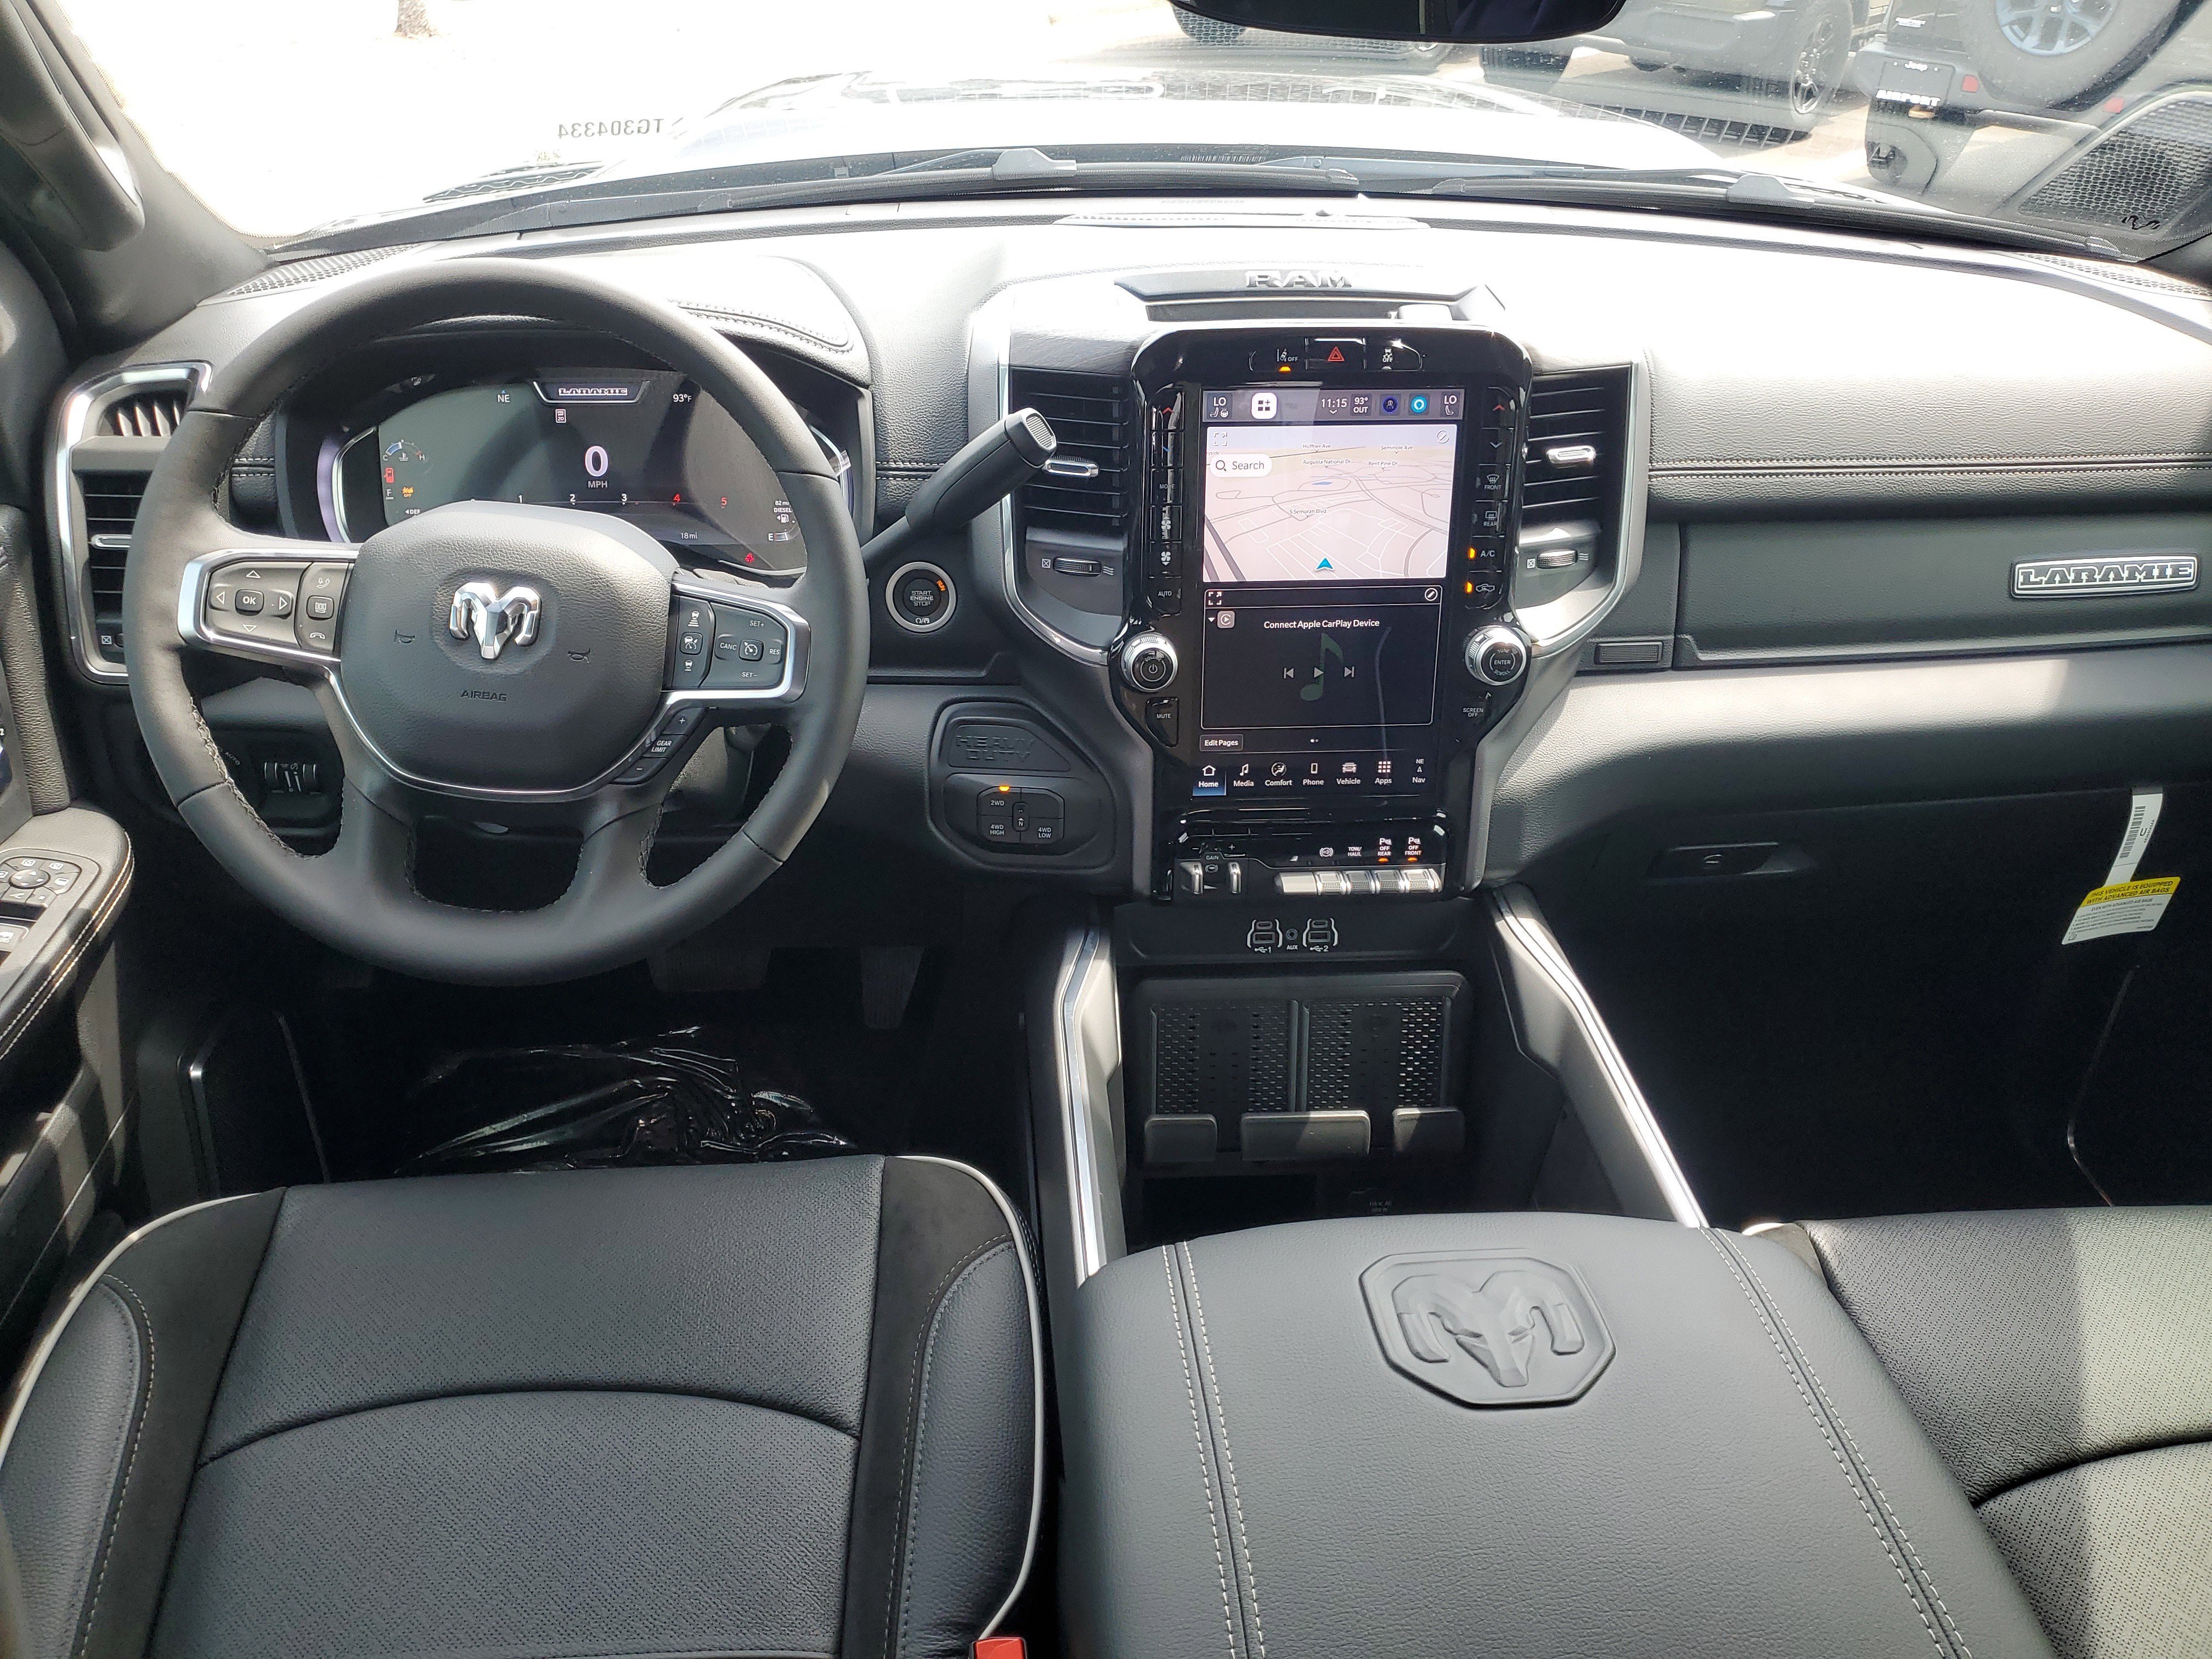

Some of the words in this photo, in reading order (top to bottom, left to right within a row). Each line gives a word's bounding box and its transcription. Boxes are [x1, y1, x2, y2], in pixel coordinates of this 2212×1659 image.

[1876, 89, 1941, 106] AIRPORT
[1244, 269, 1352, 287] RAM
[498, 394, 510, 403] NE
[673, 393, 692, 403] 93°F
[1214, 397, 1227, 407] LO
[1321, 398, 1347, 408] 11:15
[1354, 397, 1368, 405] 93°
[1444, 395, 1457, 404] LO
[585, 445, 608, 477] 0
[1232, 461, 1265, 470] Search
[518, 495, 523, 503] 1
[674, 494, 681, 503] 4
[721, 497, 727, 505] 5
[768, 533, 774, 541] E
[2018, 560, 2193, 589] LARAMIE
[936, 579, 946, 592] RUN
[242, 596, 256, 605] OK
[1263, 620, 1296, 629] Connect
[1297, 620, 1321, 629] Apple
[1322, 619, 1352, 629] CarPlay
[1353, 619, 1380, 627] Device
[720, 642, 737, 651] CANC
[459, 689, 507, 702] AIRBAG
[956, 735, 1036, 748] HEAVY
[1218, 739, 1239, 747] Pages
[966, 749, 1031, 761] DUTY
[2105, 885, 2131, 894] VEHICLE
[2140, 881, 2174, 889] EQUIPPED
[2103, 890, 2138, 901] ADVANCED
